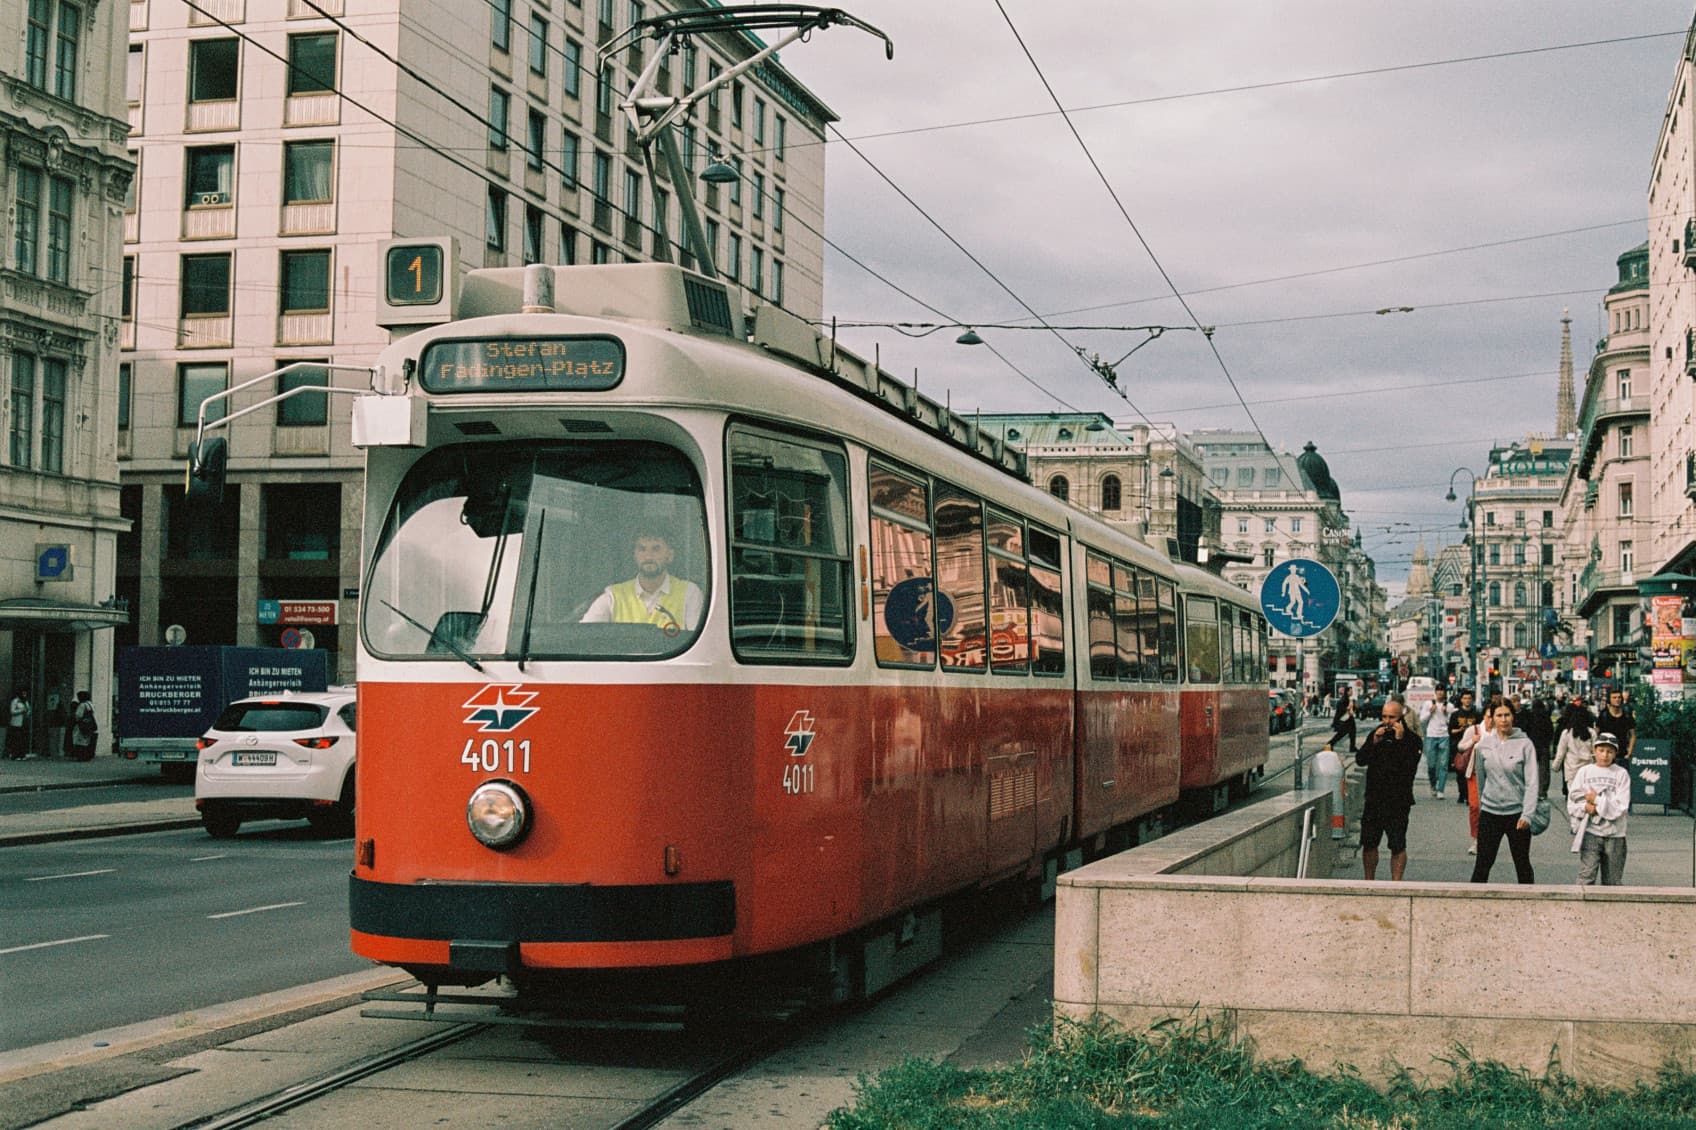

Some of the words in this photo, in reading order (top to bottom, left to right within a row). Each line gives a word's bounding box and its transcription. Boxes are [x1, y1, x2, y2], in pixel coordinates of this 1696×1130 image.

[408, 256, 421, 292] 1
[487, 342, 567, 358] Stefan
[440, 361, 614, 379] Fadinger-Platz
[461, 739, 531, 773] 4011
[783, 764, 814, 794] 4011
